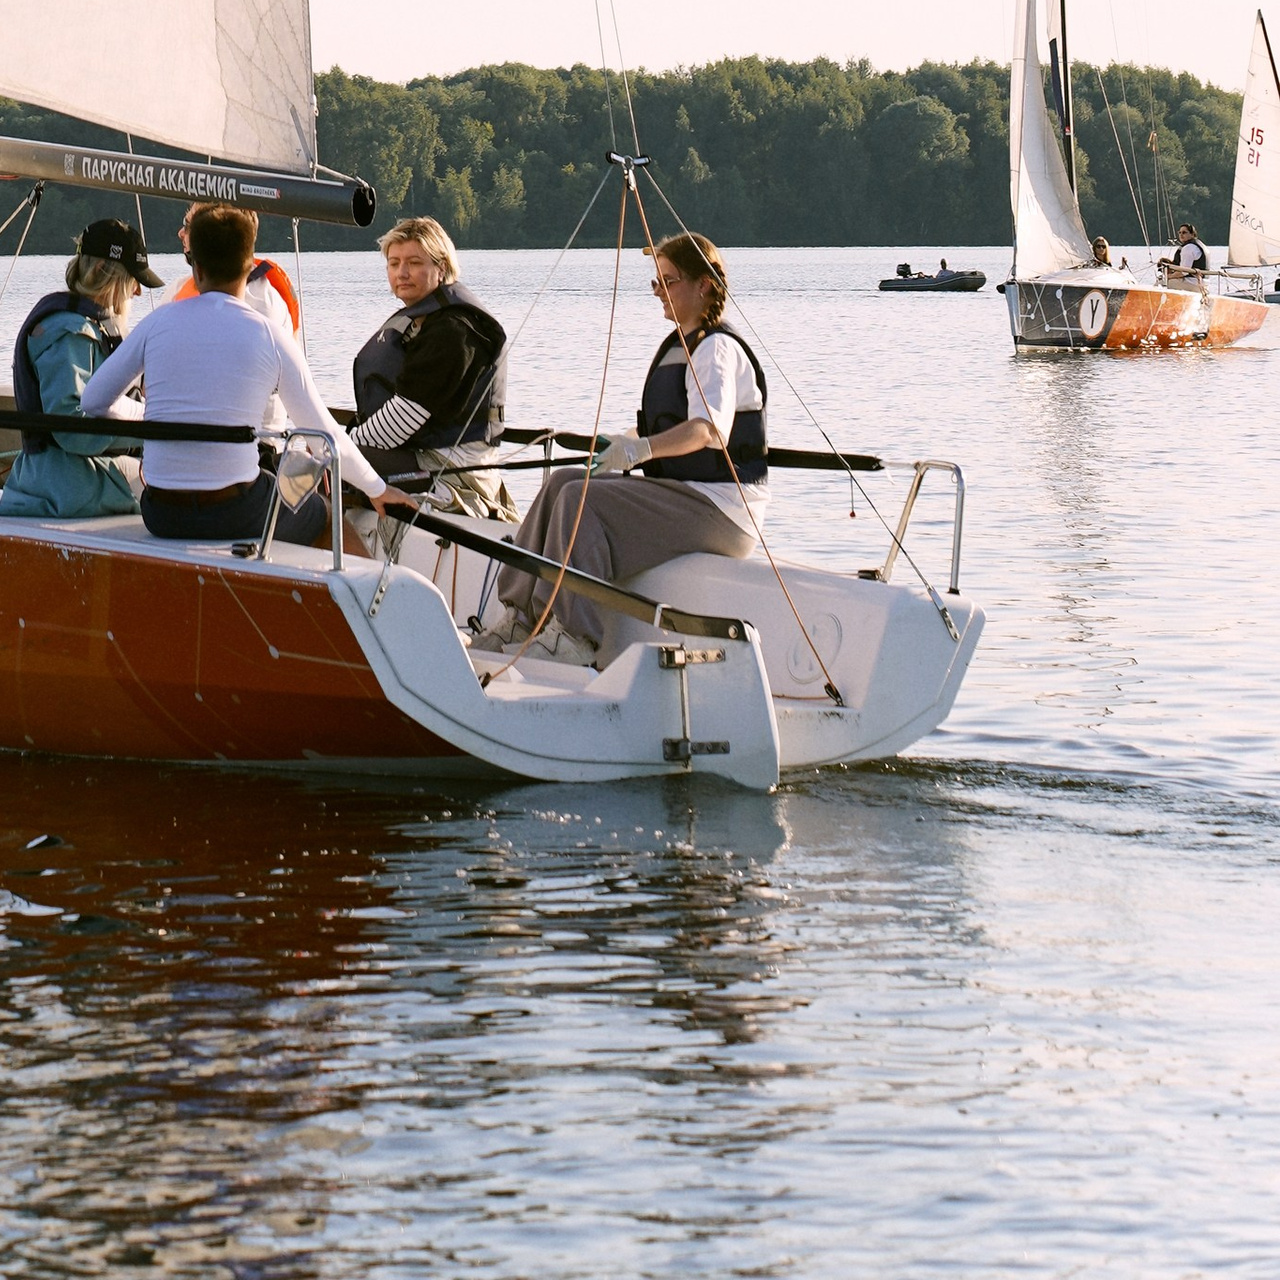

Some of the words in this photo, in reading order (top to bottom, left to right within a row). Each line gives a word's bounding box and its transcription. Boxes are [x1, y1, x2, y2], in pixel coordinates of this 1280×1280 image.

[1250, 126, 1264, 146] 15
[82, 156, 155, 189] ПАРУСНАЯ
[158, 167, 238, 202] АКАДЕМИЯ
[1090, 299, 1100, 329] Y
